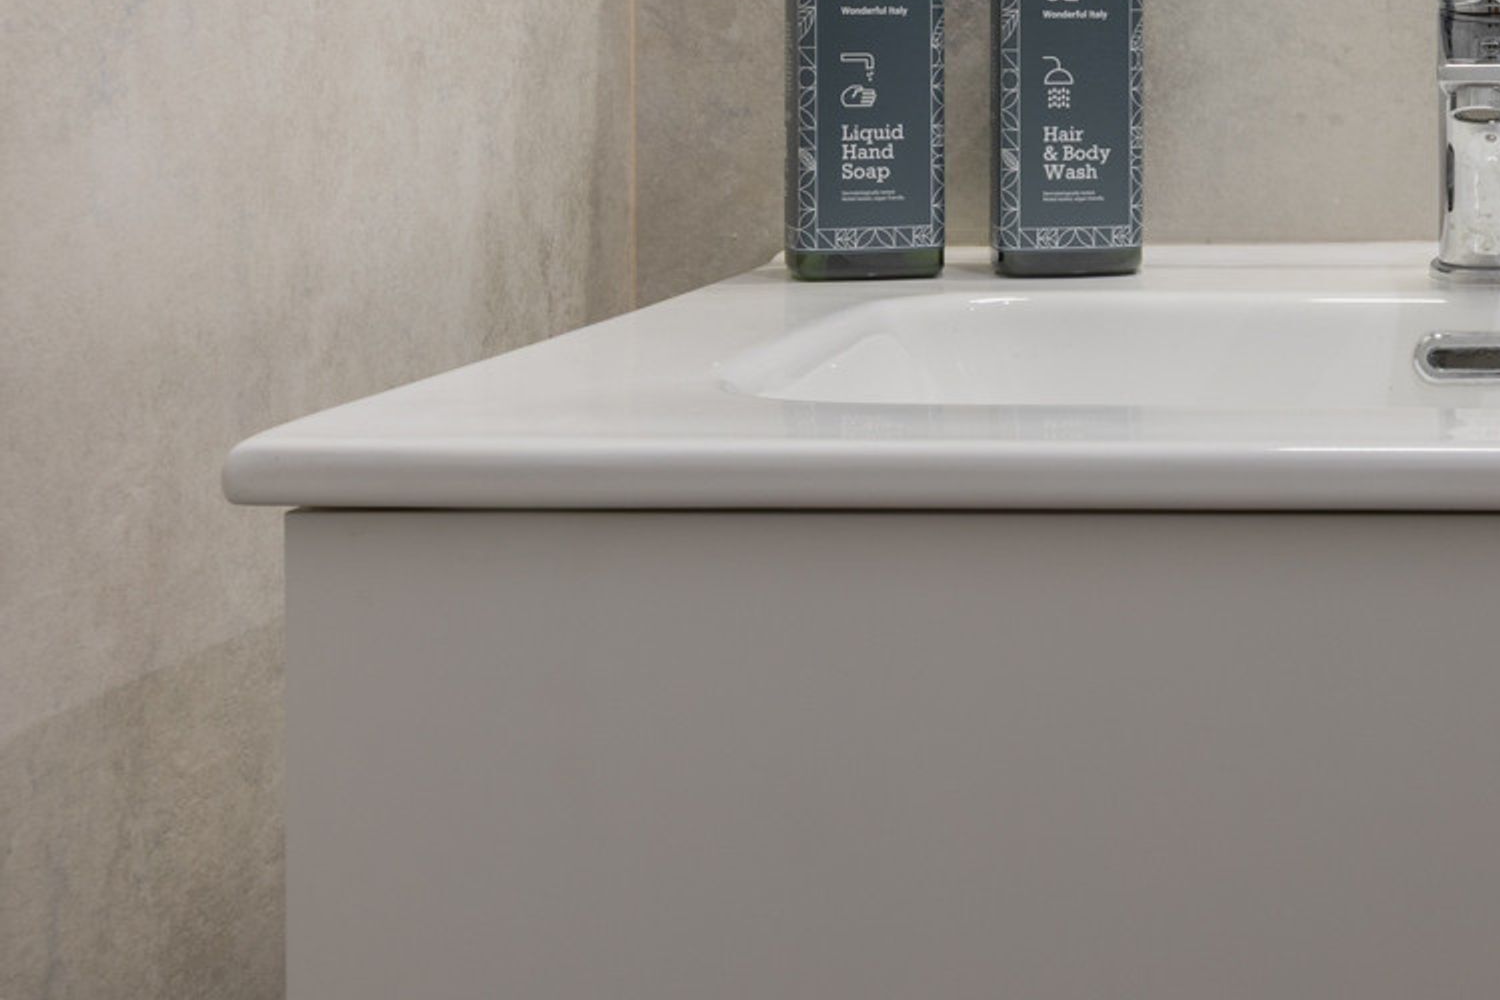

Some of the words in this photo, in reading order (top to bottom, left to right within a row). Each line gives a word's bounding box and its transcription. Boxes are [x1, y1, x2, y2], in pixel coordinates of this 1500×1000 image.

[841, 5, 888, 16] Wonderful
[889, 5, 908, 17] Italy
[1042, 9, 1088, 19] Wonderful
[1089, 9, 1108, 21] Italy
[841, 124, 905, 143] Liquid
[1043, 126, 1084, 142] Hair
[841, 143, 895, 160] Hand
[1043, 147, 1059, 162] &
[1063, 145, 1111, 165] Body
[841, 163, 891, 183] Soap
[1043, 163, 1099, 180] Wash
